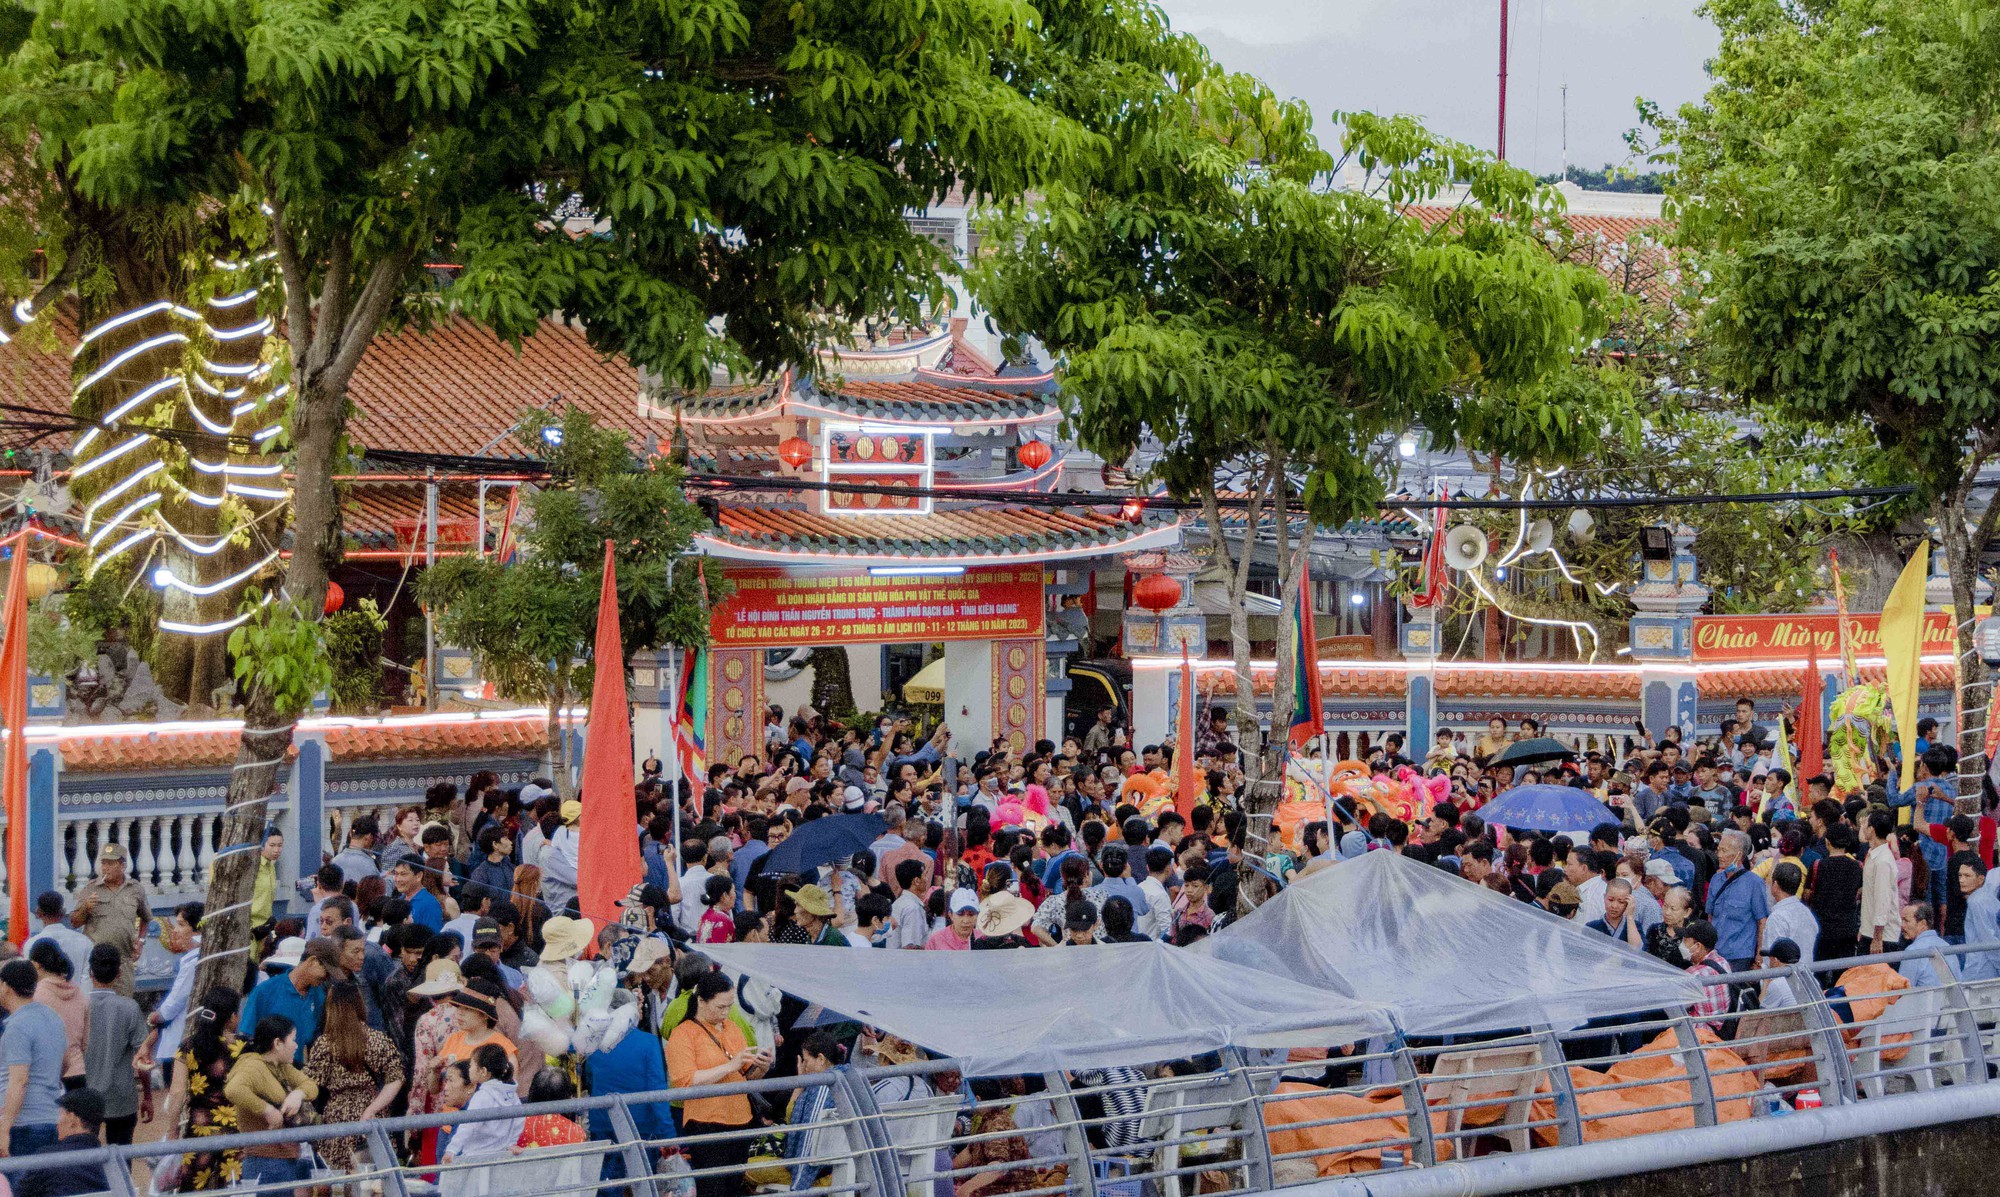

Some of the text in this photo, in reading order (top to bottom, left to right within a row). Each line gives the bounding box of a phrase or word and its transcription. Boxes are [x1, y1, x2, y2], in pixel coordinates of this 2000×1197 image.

[840, 577, 853, 587] 155
[976, 573, 992, 583] SINH
[905, 590, 917, 601] PHI
[967, 589, 980, 599] GIA
[802, 605, 831, 620] NGUYỄN
[832, 608, 856, 619] TRUNG
[882, 605, 905, 617] THÀNH
[907, 603, 921, 617] PHỐ
[922, 605, 941, 618] RẠCH
[737, 624, 756, 637] CHỨC
[775, 625, 788, 637] CÁC
[790, 624, 809, 636] NGÀY
[811, 626, 821, 636] 26
[826, 625, 836, 635] 27
[842, 625, 851, 635] 28
[852, 622, 876, 635] THÁNG
[877, 624, 882, 633] 8
[883, 621, 895, 633] ÂM
[897, 622, 912, 634] LỊCH
[914, 622, 925, 633] (10
[932, 622, 940, 632] 11
[947, 622, 955, 631] 12
[957, 619, 979, 631] THÁNG
[982, 621, 990, 630] 10
[991, 618, 1007, 629] NĂM
[1008, 618, 1028, 630] 2023)
[1698, 624, 1760, 650] Chào
[1764, 622, 1836, 651] Mừng
[925, 691, 941, 701] 099
